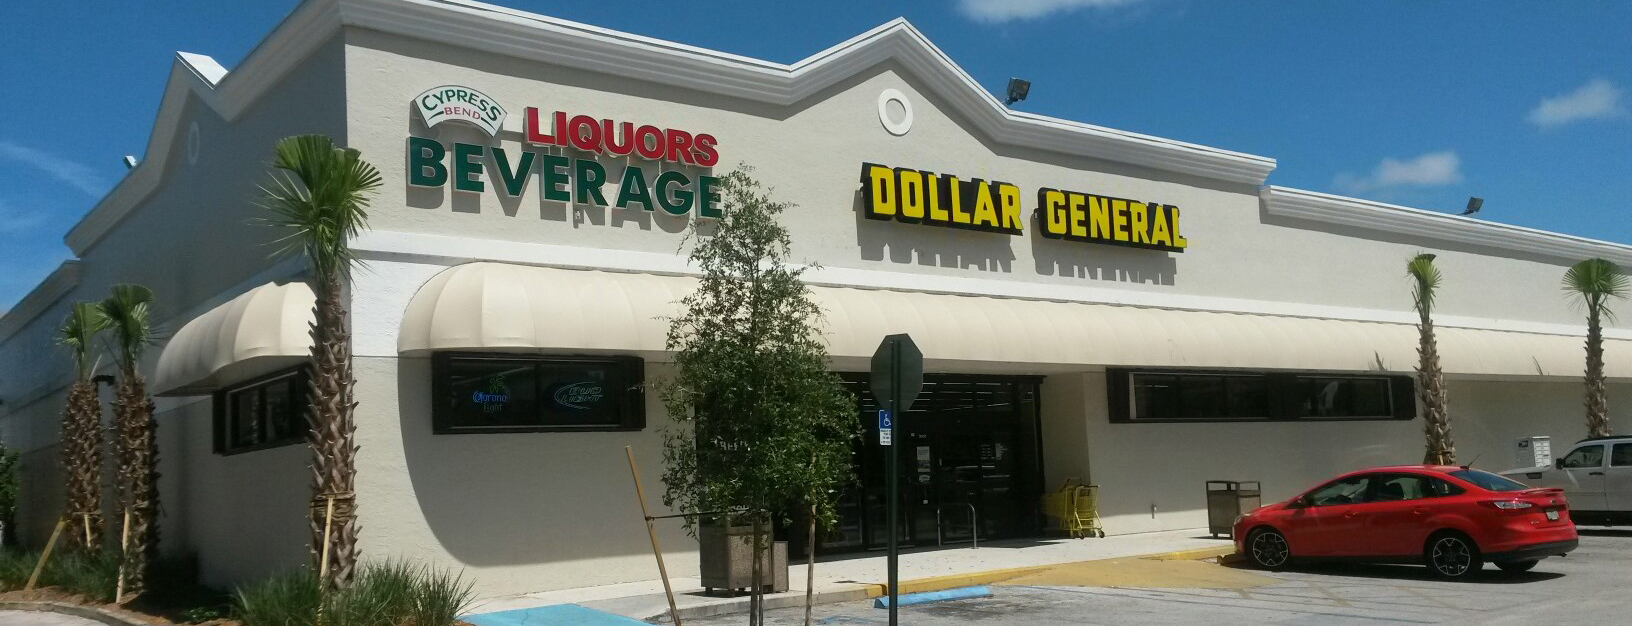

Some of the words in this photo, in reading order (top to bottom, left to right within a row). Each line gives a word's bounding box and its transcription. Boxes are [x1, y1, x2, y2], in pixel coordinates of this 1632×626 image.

[422, 89, 501, 121] CYPRESS
[444, 106, 481, 120] BEND
[525, 106, 719, 167] LIQUORS
[407, 136, 723, 218] BEVERAGE
[869, 165, 1025, 231] DOLLAR
[1045, 189, 1188, 249] GENERAL
[472, 390, 508, 404] Corona
